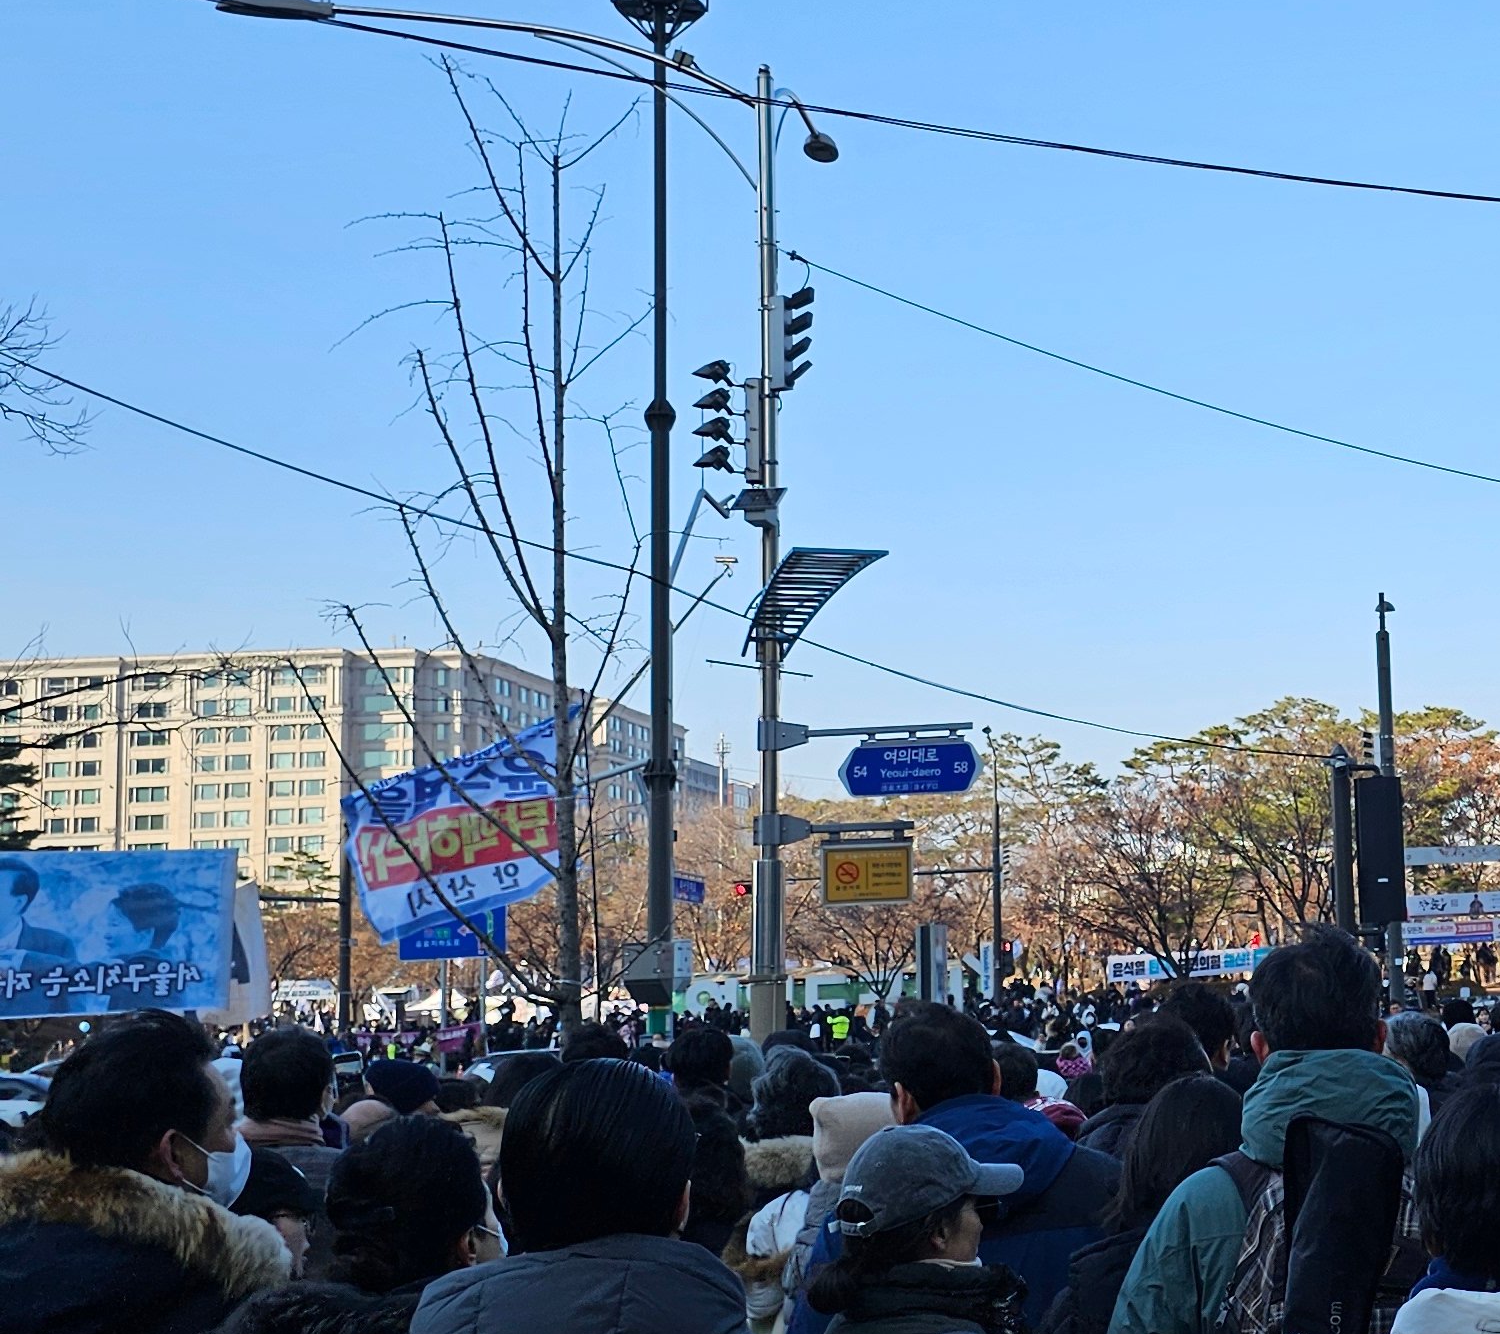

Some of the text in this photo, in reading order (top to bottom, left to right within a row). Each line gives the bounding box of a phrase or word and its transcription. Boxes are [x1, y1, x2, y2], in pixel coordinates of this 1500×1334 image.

[884, 748, 940, 764] 여의대로
[853, 765, 868, 778] 54
[880, 767, 942, 779] Yeoui-daero
[953, 761, 969, 774] 58
[1112, 960, 1146, 978] 윤석열
